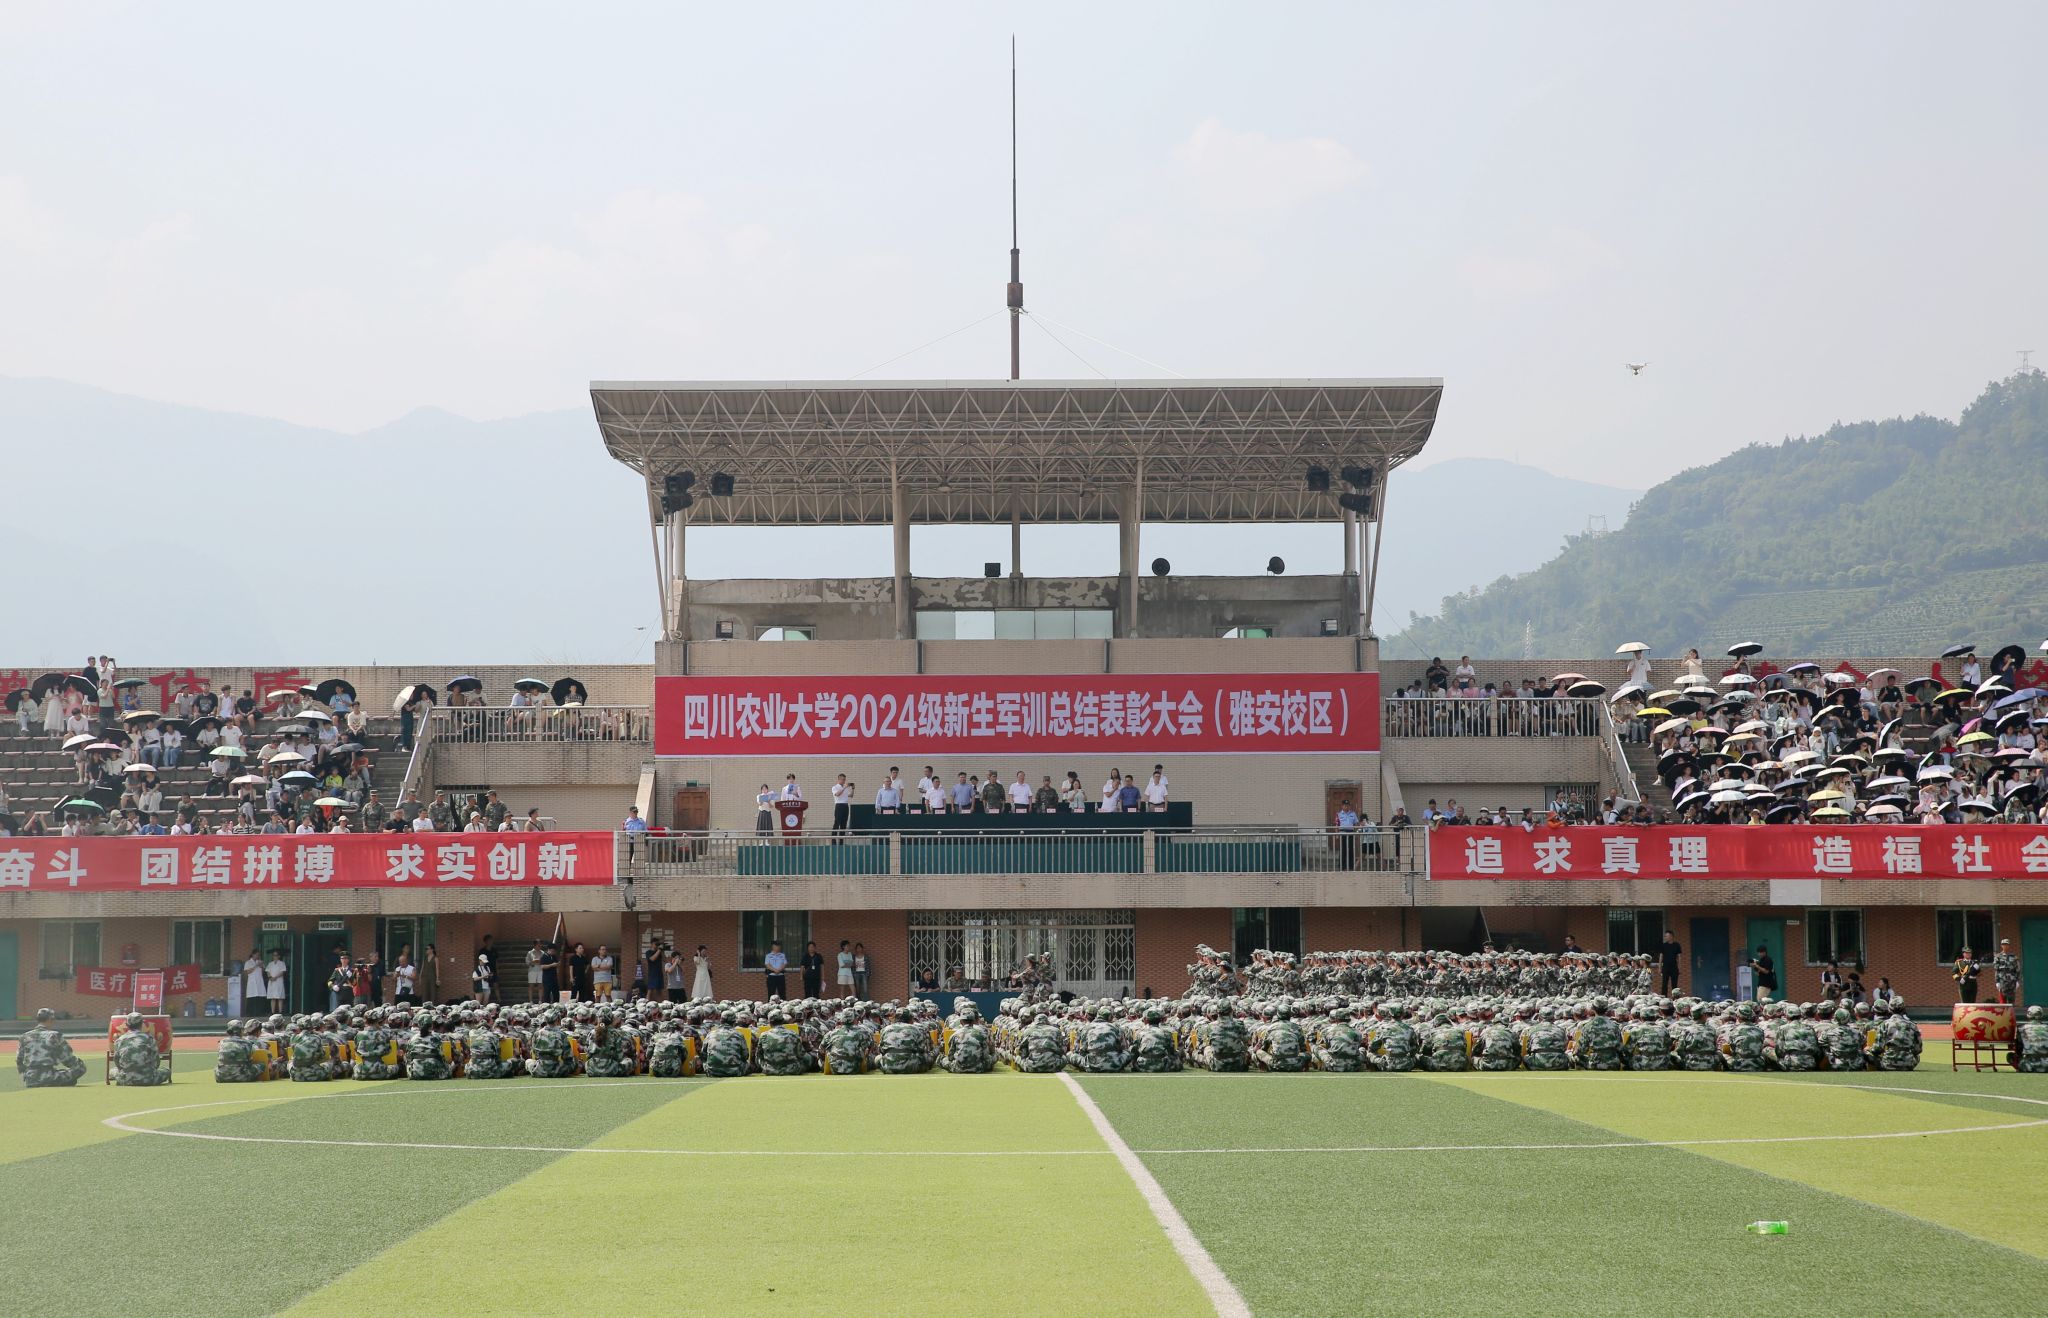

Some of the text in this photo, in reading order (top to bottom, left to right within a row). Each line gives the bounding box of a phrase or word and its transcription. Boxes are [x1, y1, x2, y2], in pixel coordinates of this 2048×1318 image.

[684, 689, 1349, 740] 四川农业大学2024级新生军训总结表彰大会（雅安校区）
[0, 842, 578, 888] 奋斗 团结拼搏 求实创新
[1465, 834, 2048, 874] 追求真理 造福社会
[90, 970, 188, 992] 医疗点
